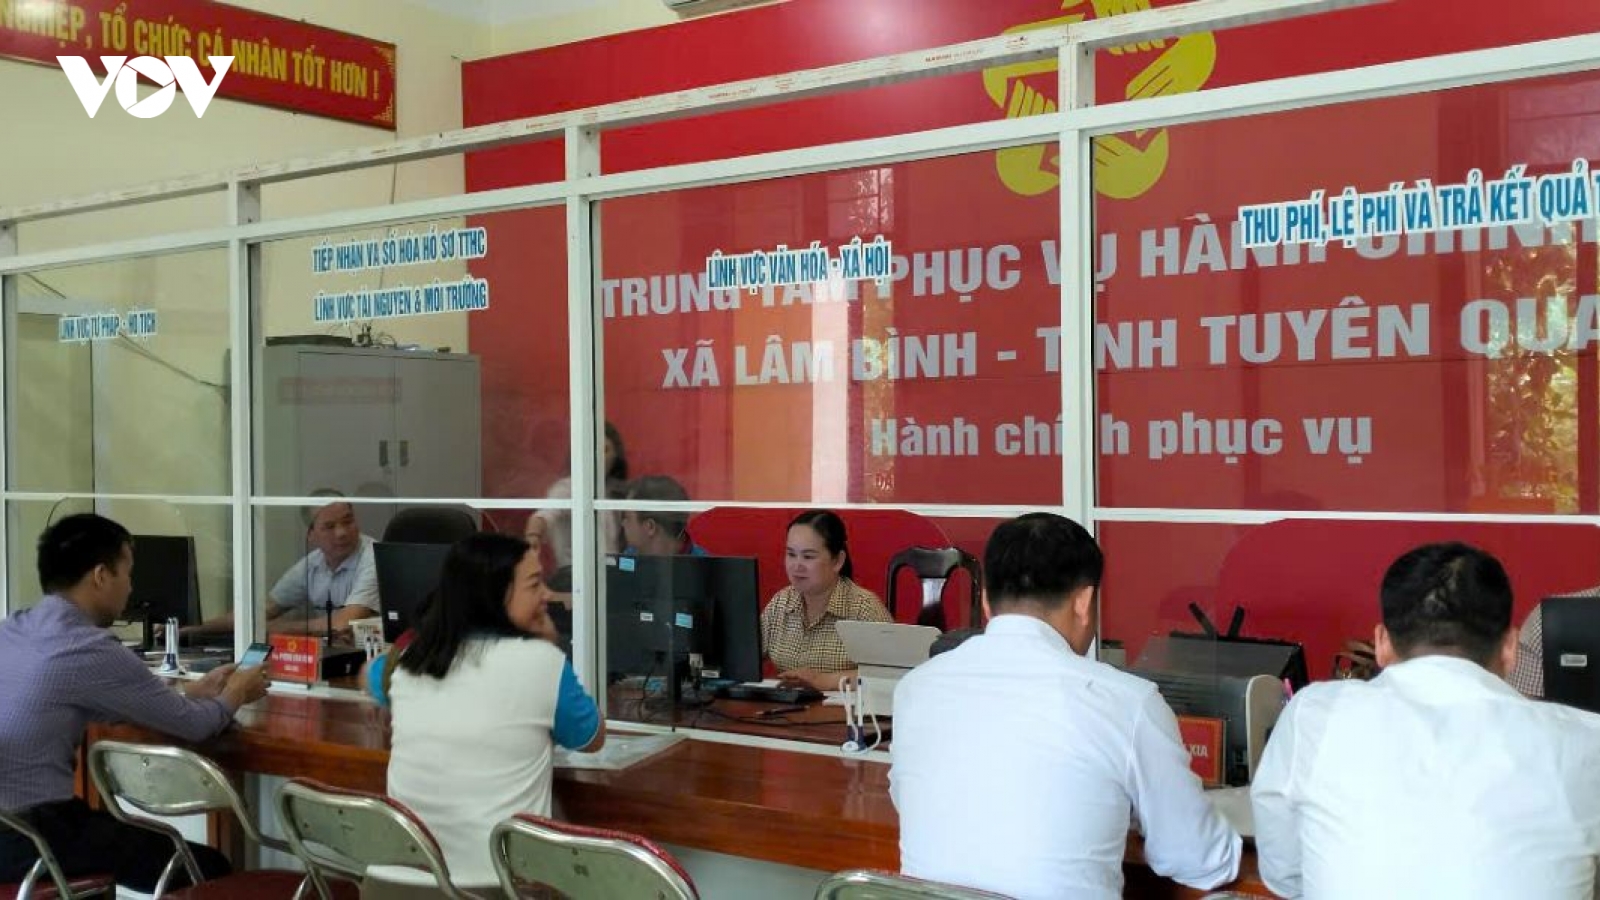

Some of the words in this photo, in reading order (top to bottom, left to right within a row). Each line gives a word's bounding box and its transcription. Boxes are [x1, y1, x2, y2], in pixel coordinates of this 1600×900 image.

[98, 2, 127, 51] TỔ
[133, 15, 192, 58] CHỨC
[231, 37, 288, 81] NHÂN
[292, 44, 325, 89] TỐT
[330, 59, 368, 98] HƠN
[1242, 206, 1280, 246] THU
[1286, 191, 1327, 243] PHÍ,
[1332, 188, 1355, 246] LỆ
[1362, 183, 1397, 235] PHÍ
[1405, 181, 1433, 229] VÀ
[1439, 170, 1483, 226] TRẢ
[1490, 166, 1532, 222] KẾT
[1540, 160, 1588, 222] QUẢ
[458, 229, 484, 256] TTHC
[740, 252, 766, 294] VỰC
[768, 248, 796, 285] VĂN
[842, 238, 861, 278] XÃ
[865, 238, 889, 284] HỘI
[414, 289, 421, 313] &
[662, 338, 720, 390] XÃ
[735, 334, 836, 387] LÂM
[852, 326, 977, 382] BÌNH
[1036, 319, 1177, 372] TNH
[1200, 296, 1430, 366] TUYÊN
[872, 416, 979, 457] Hành
[995, 412, 1130, 456] chíh
[1148, 411, 1283, 464] phục
[1303, 416, 1372, 464] vụ
